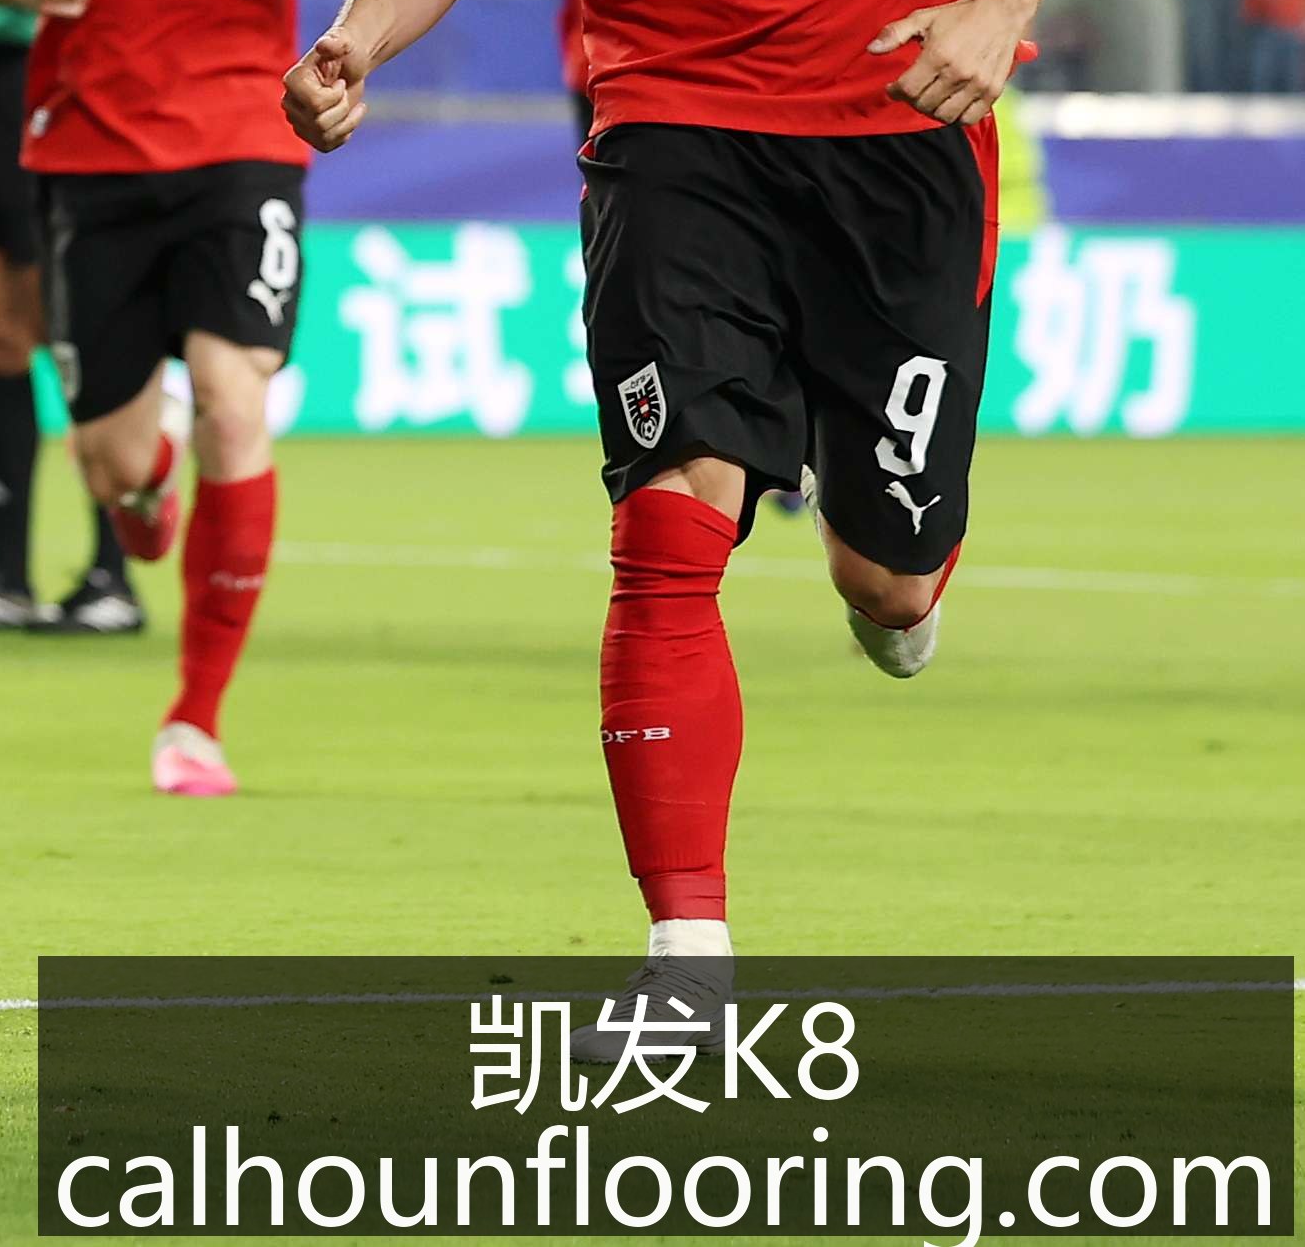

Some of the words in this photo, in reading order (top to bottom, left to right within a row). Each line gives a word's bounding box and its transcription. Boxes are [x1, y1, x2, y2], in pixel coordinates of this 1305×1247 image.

[257, 198, 300, 290] 6
[1011, 218, 1195, 438] 奶
[874, 355, 948, 478] 9
